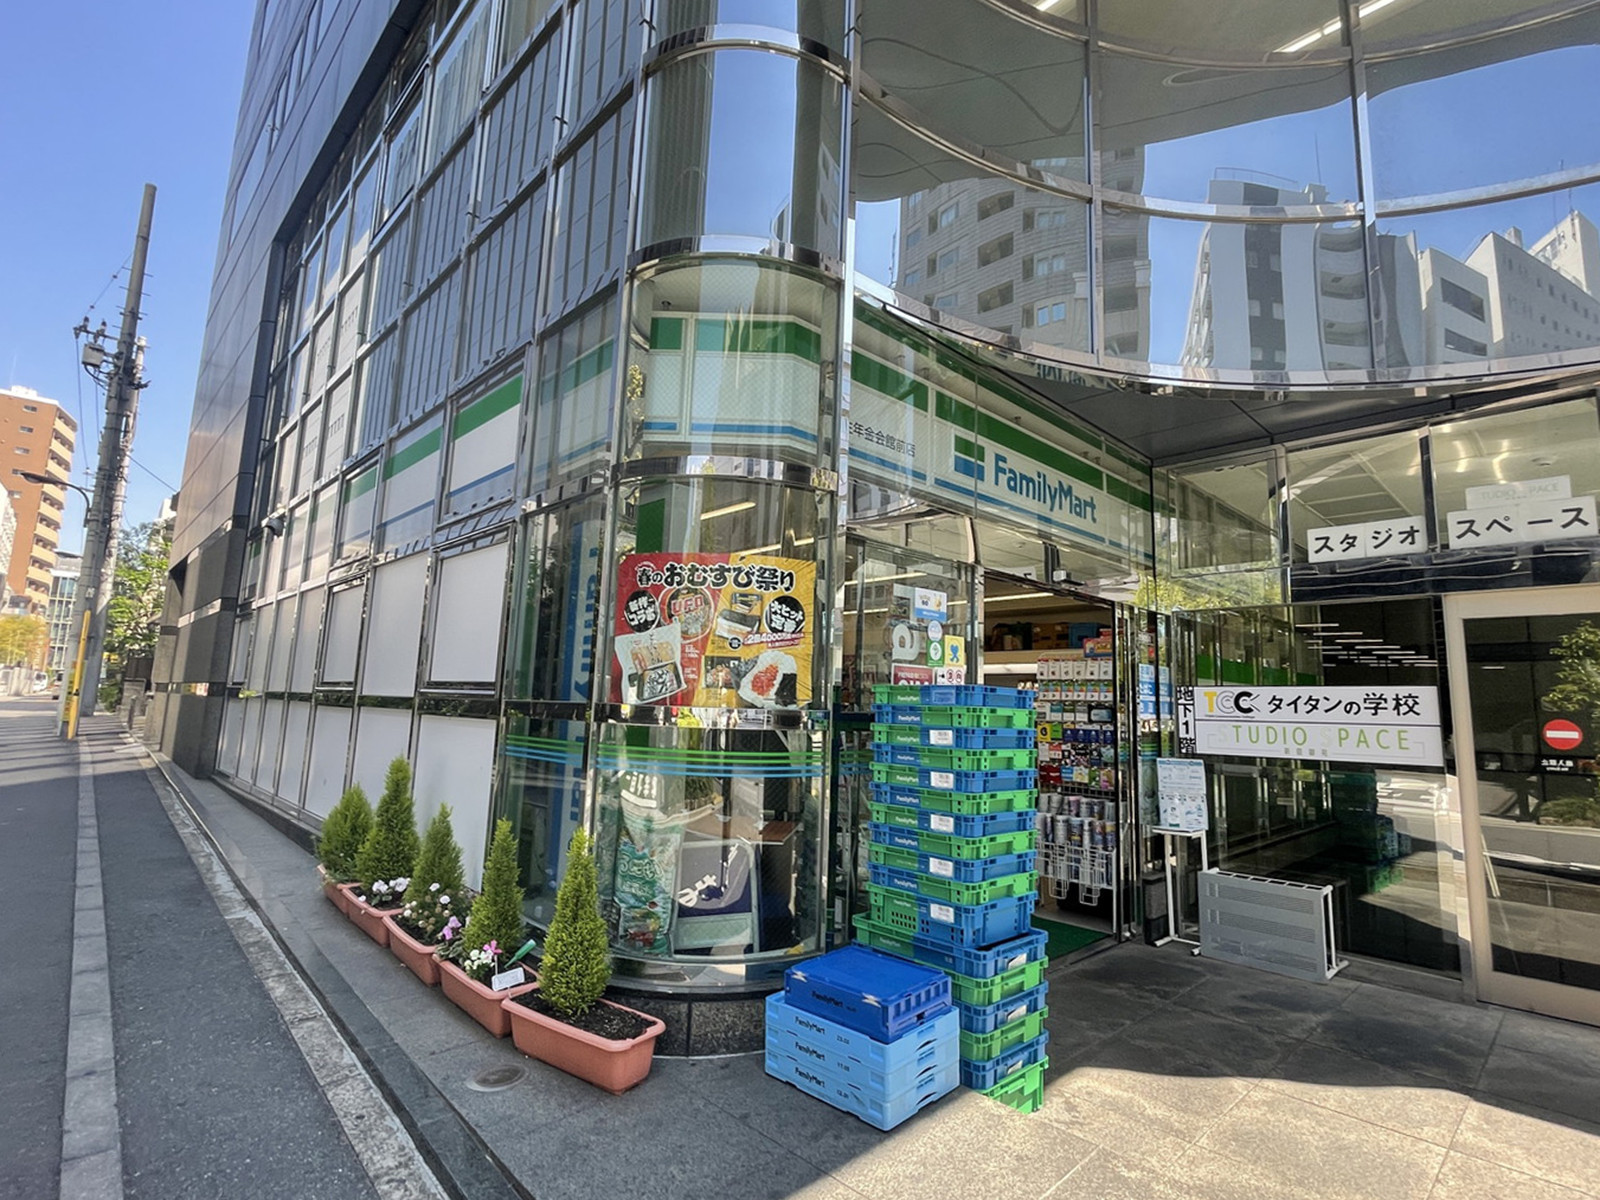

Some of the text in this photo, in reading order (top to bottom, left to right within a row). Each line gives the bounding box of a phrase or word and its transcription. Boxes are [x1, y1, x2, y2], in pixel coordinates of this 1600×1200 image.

[993, 452, 1097, 524] FamilyMart
[1456, 507, 1590, 540] スペース
[1314, 525, 1420, 554] スタジオ
[637, 562, 795, 593] 春のおむすび祭り
[770, 600, 804, 622] 大ヒット
[1267, 693, 1422, 717] タイタンの学校
[1177, 686, 1197, 755] 地下1階
[795, 1016, 826, 1035] FamilyMart
[795, 1041, 826, 1061] FamilyMart
[795, 1066, 826, 1088] FamilyMart
